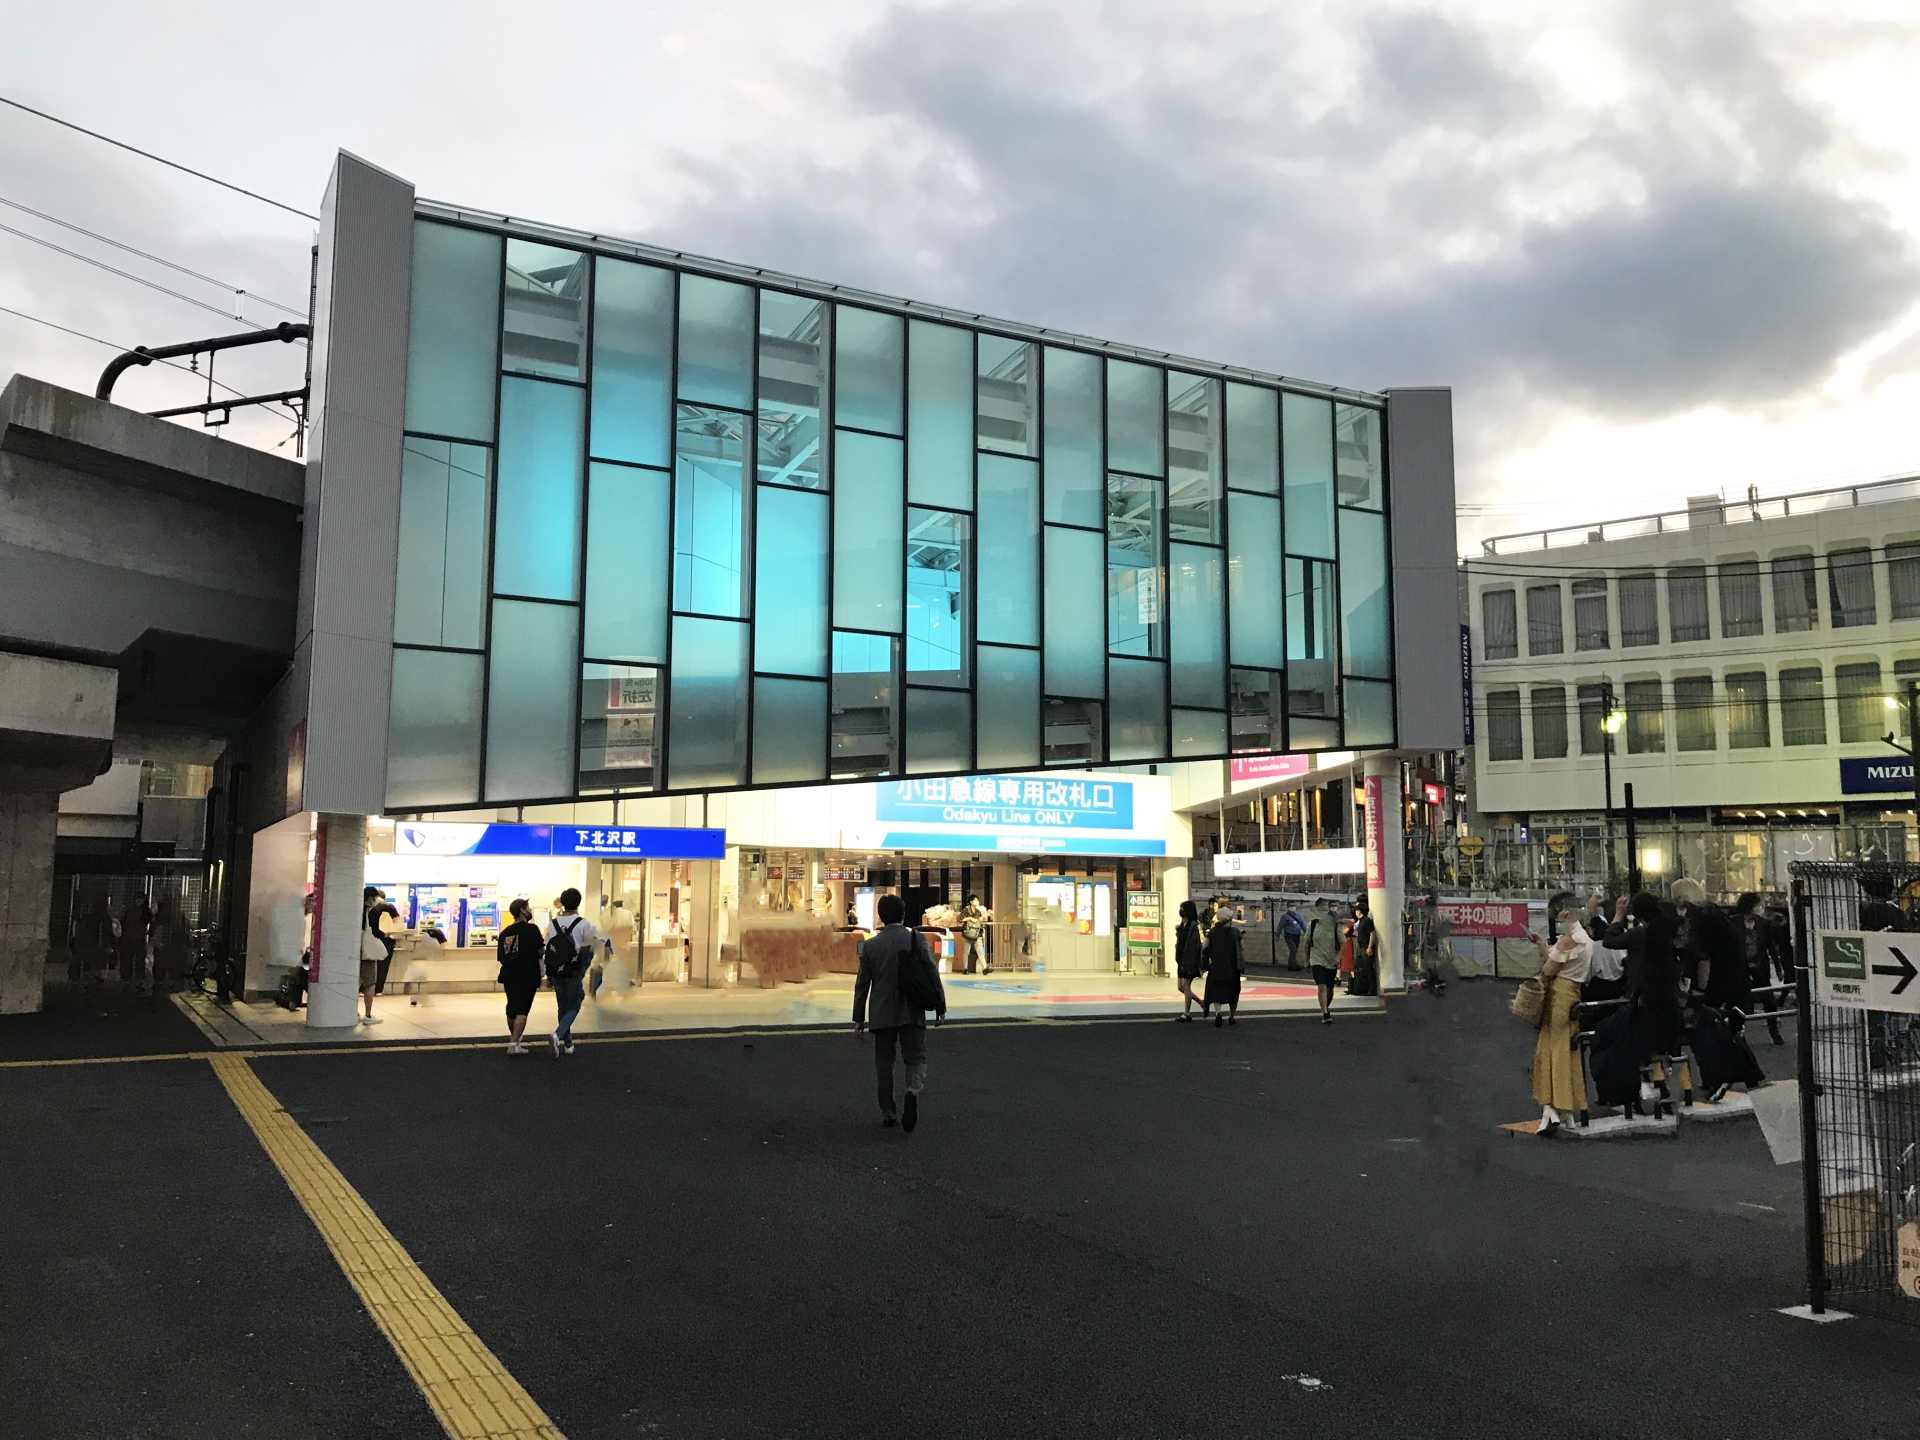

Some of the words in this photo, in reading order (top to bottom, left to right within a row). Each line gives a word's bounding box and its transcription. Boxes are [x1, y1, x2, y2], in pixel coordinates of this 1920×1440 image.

[1259, 763, 1279, 771] Inokashira
[897, 778, 1114, 809] 小田急線専用改札口
[943, 807, 998, 824] Odakyu
[1001, 808, 1031, 823] Line
[1035, 810, 1075, 825] ONLY
[575, 830, 636, 845] 下北沢駅
[1366, 797, 1379, 879] 京王井の頭線
[409, 888, 415, 896] 2
[1130, 895, 1159, 906] 小田急線
[1145, 911, 1157, 919] 入口
[1832, 983, 1861, 994] 喫煙所
